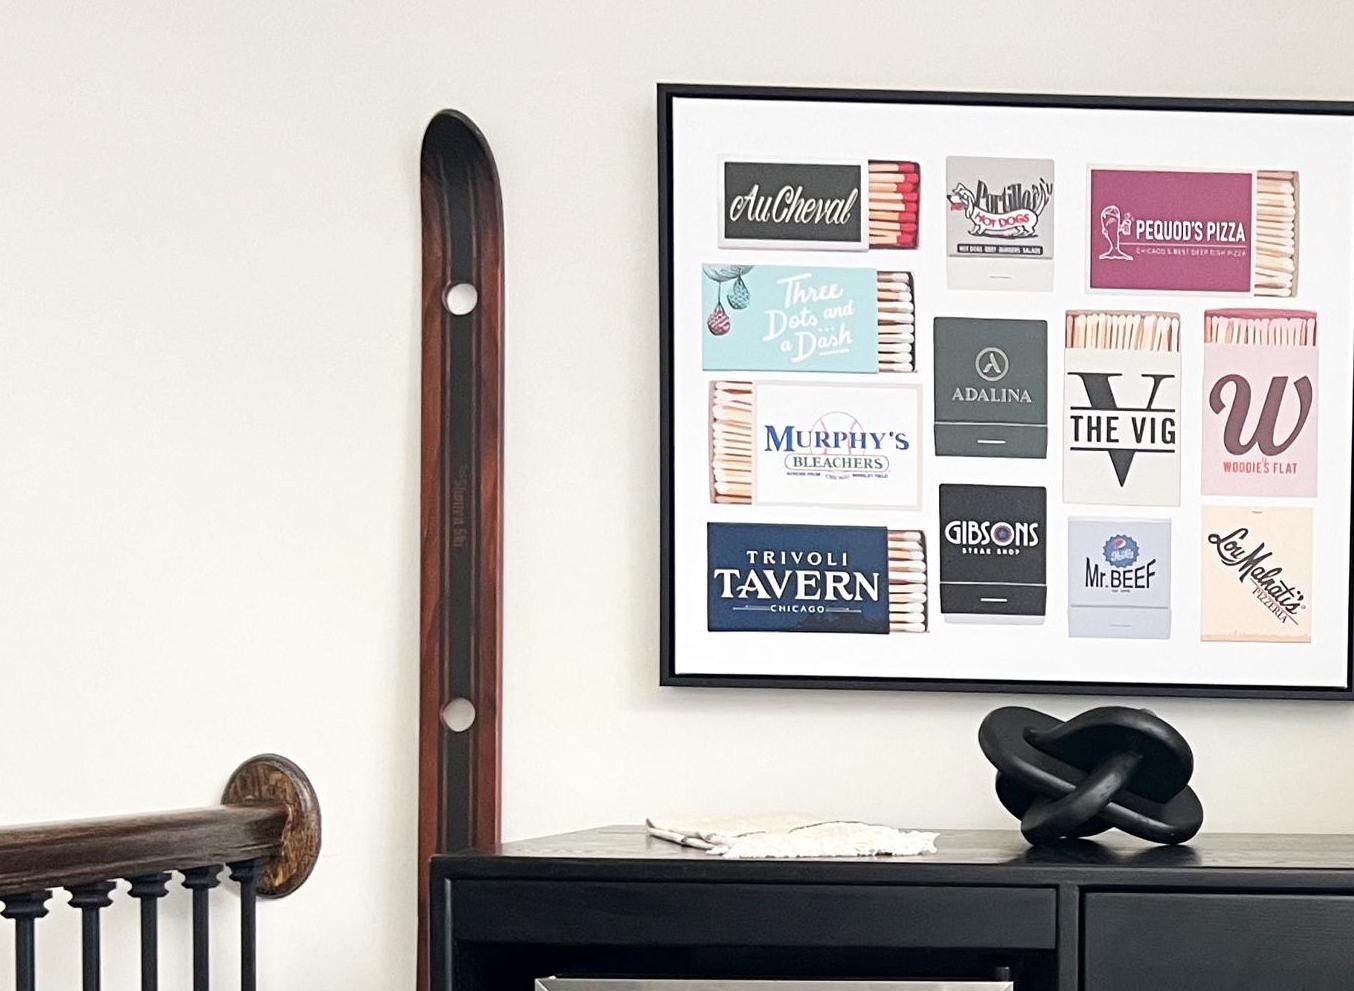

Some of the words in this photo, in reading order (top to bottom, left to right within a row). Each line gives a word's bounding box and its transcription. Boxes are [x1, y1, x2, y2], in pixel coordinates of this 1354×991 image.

[730, 184, 772, 222] Au
[772, 185, 859, 225] Cheval
[974, 211, 996, 228] HOT
[998, 213, 1030, 228] DOGS
[1136, 220, 1203, 241] PEQUOD'S
[1207, 222, 1246, 242] PIZZA
[777, 273, 844, 309] Three
[762, 308, 818, 341] Dots
[823, 300, 855, 319] and
[780, 340, 794, 353] a
[790, 326, 854, 363] Dash
[952, 387, 1033, 403] ADALINA
[764, 424, 910, 453] MURPHY'S
[1070, 415, 1120, 444] THE
[1132, 416, 1176, 445] VIG
[793, 456, 884, 470] BLEACHERS
[1223, 459, 1270, 477] WOODIE'S
[1273, 462, 1298, 478] FLAT
[945, 520, 1040, 547] GIBSONS
[1207, 527, 1250, 563] Lou
[747, 550, 848, 566] TRIVOLI
[1085, 557, 1109, 588] Mr.
[1110, 558, 1157, 589] BEEF
[713, 568, 881, 602] TAVERN
[1221, 541, 1304, 615] Malnati's
[770, 604, 826, 614] CHICAGO
[1252, 587, 1288, 624] PIZZERIA
